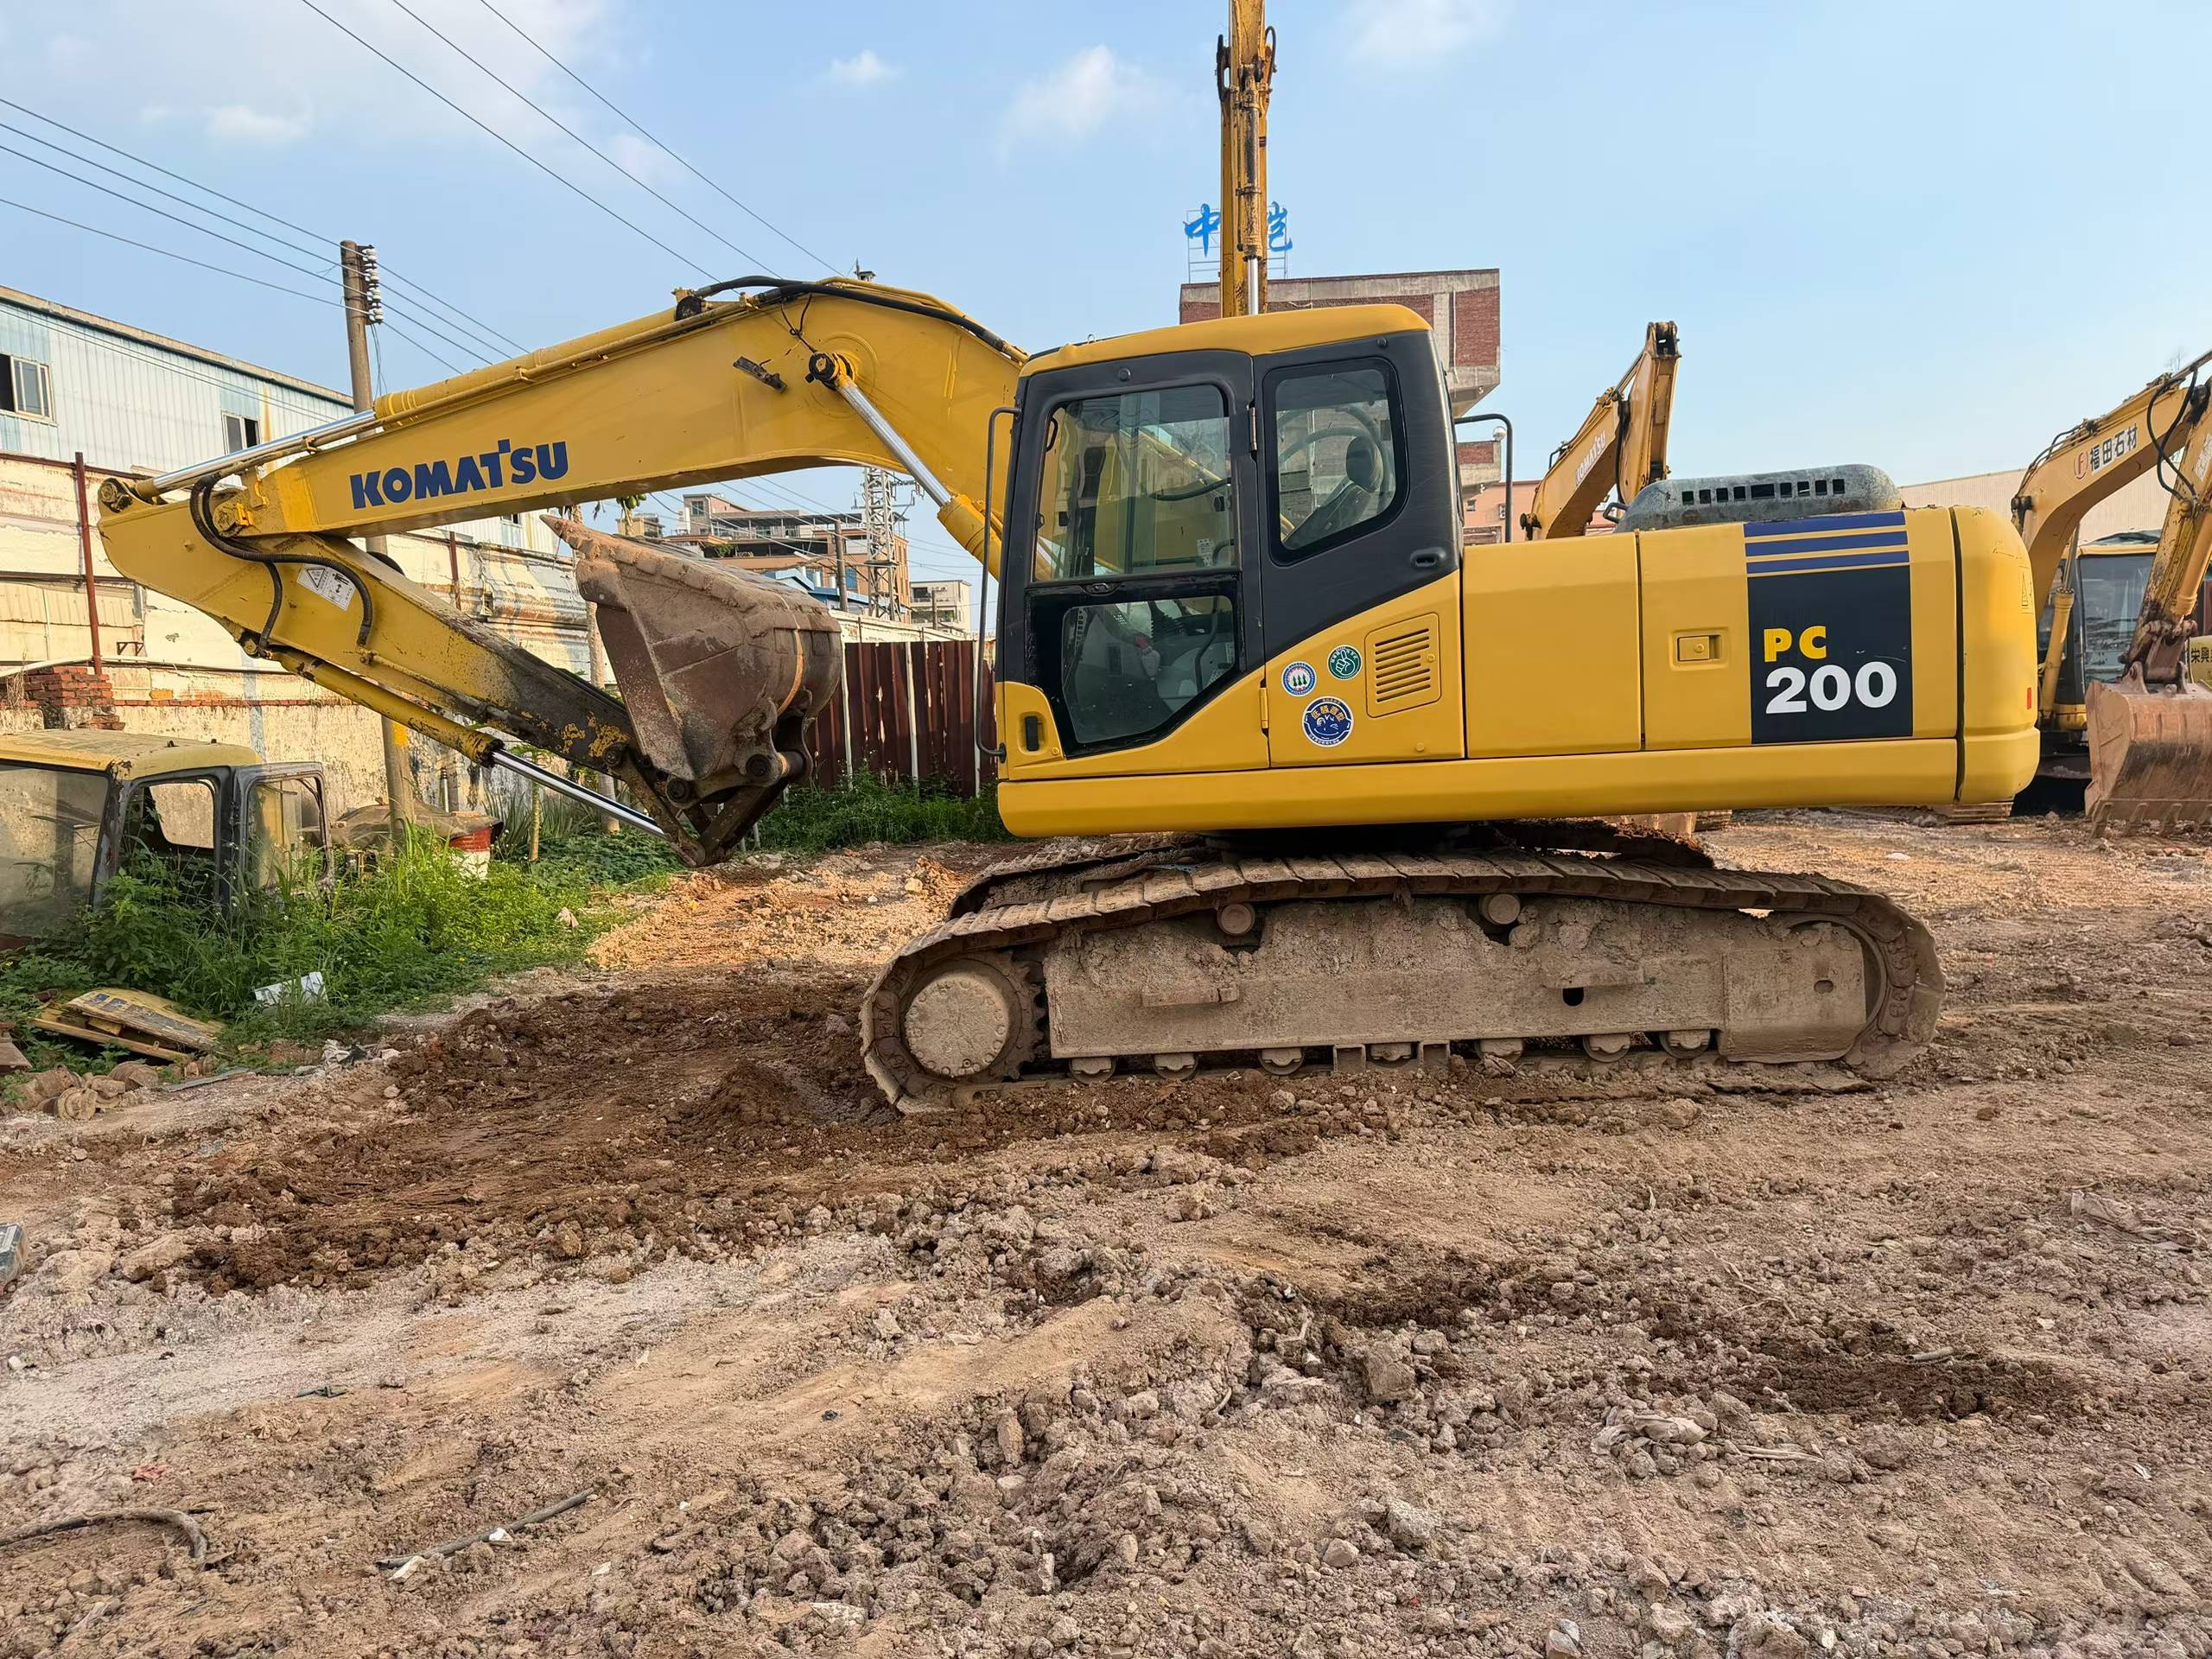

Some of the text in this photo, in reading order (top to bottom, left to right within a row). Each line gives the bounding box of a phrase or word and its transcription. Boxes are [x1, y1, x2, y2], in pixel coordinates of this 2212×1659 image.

[2090, 423, 2138, 472] 福田石材
[349, 438, 569, 510] KOMATSU
[1764, 625, 1827, 663] PC
[2190, 647, 2212, 664] 栄興
[1765, 661, 1897, 714] 200
